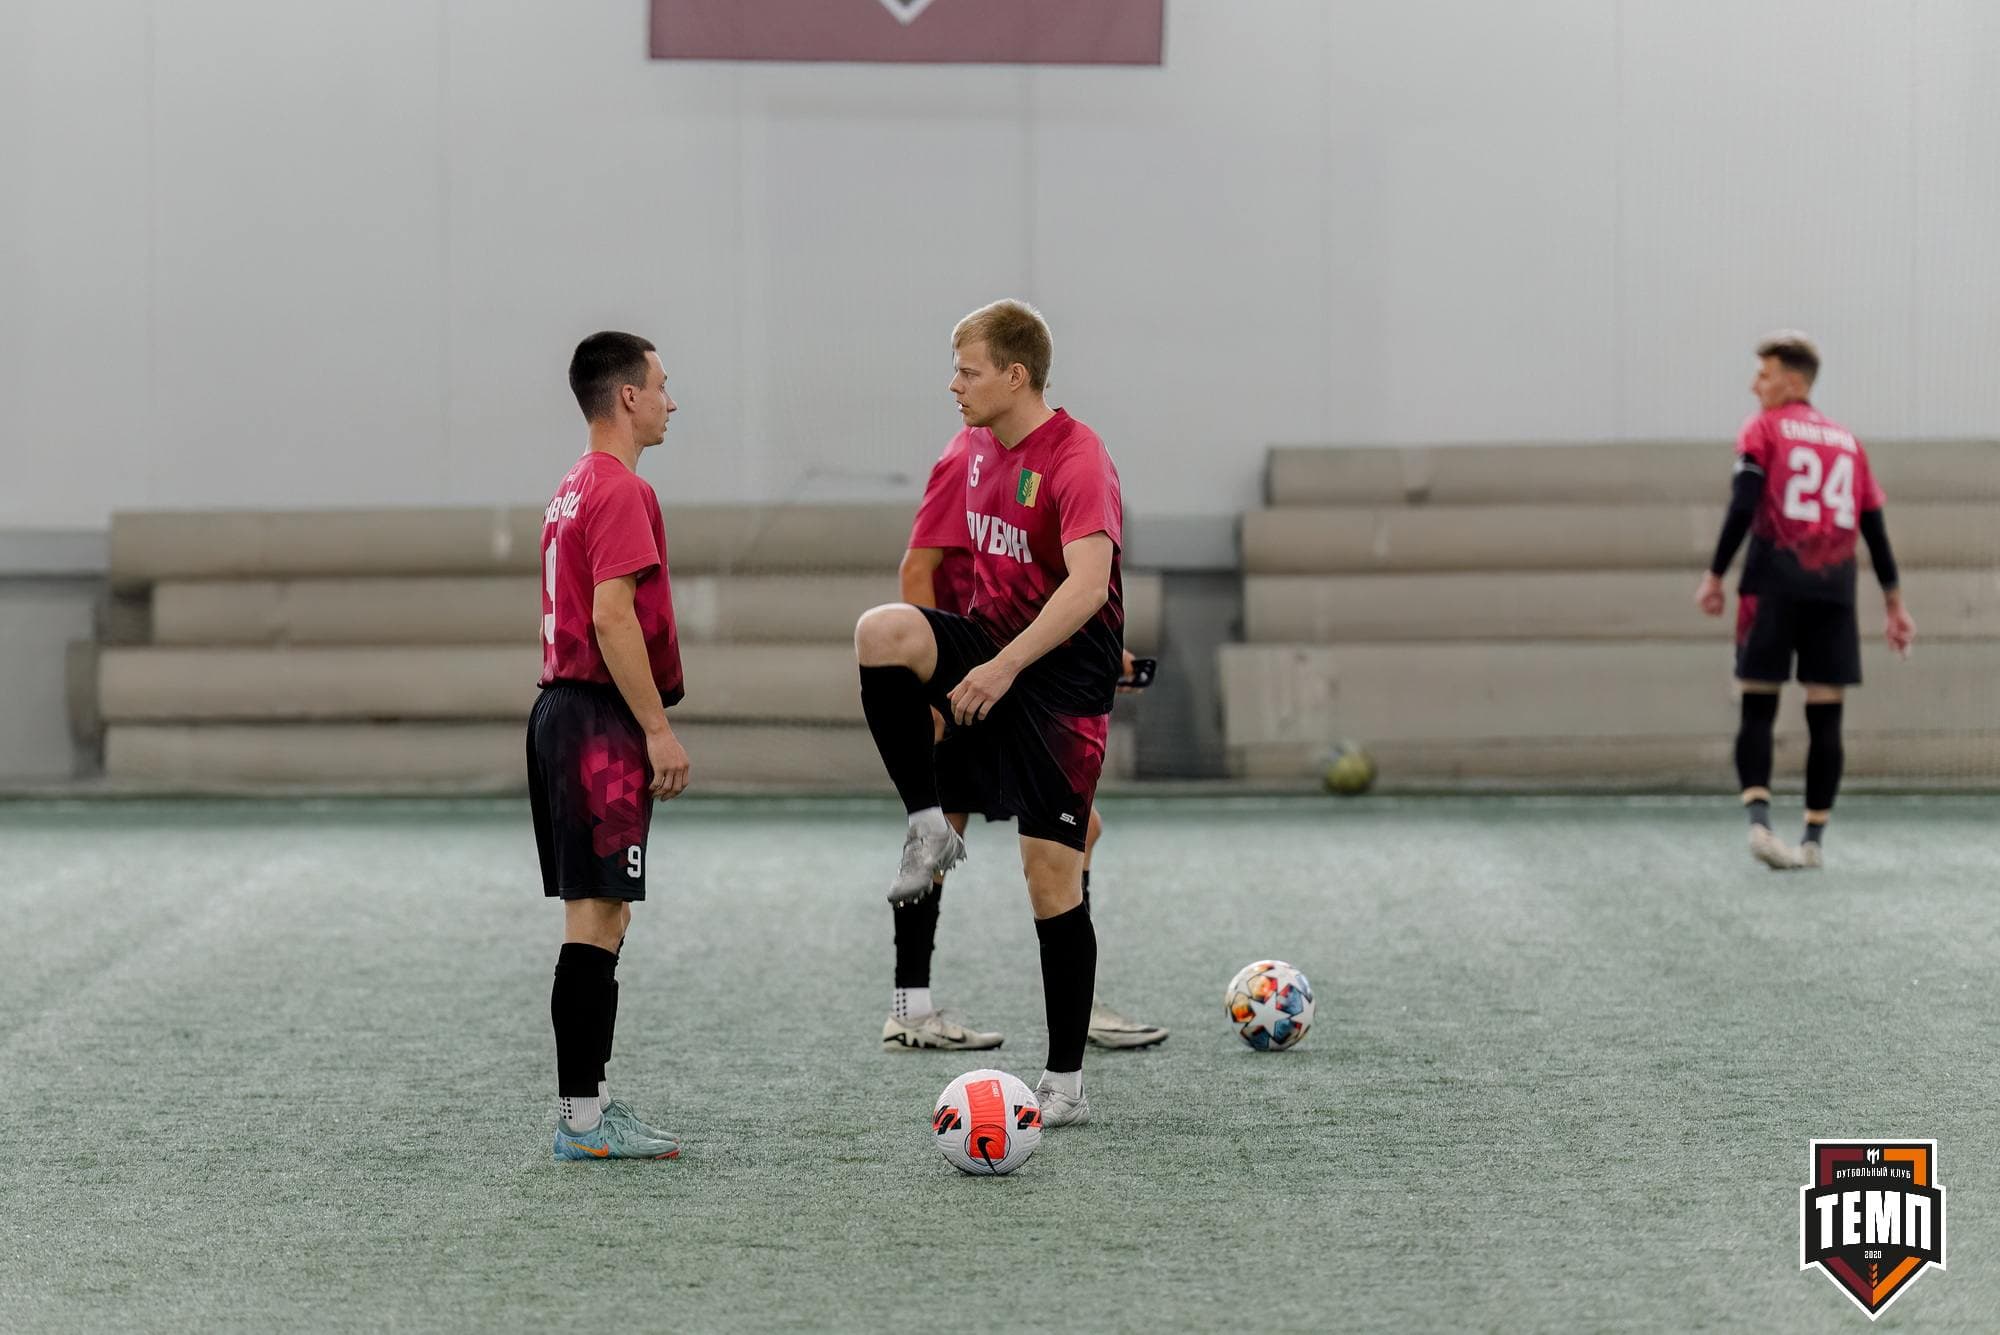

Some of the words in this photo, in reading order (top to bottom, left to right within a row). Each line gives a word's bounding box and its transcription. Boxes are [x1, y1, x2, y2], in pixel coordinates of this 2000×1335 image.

[970, 454, 984, 488] 5
[1783, 446, 1856, 530] 24
[627, 845, 642, 878] 9
